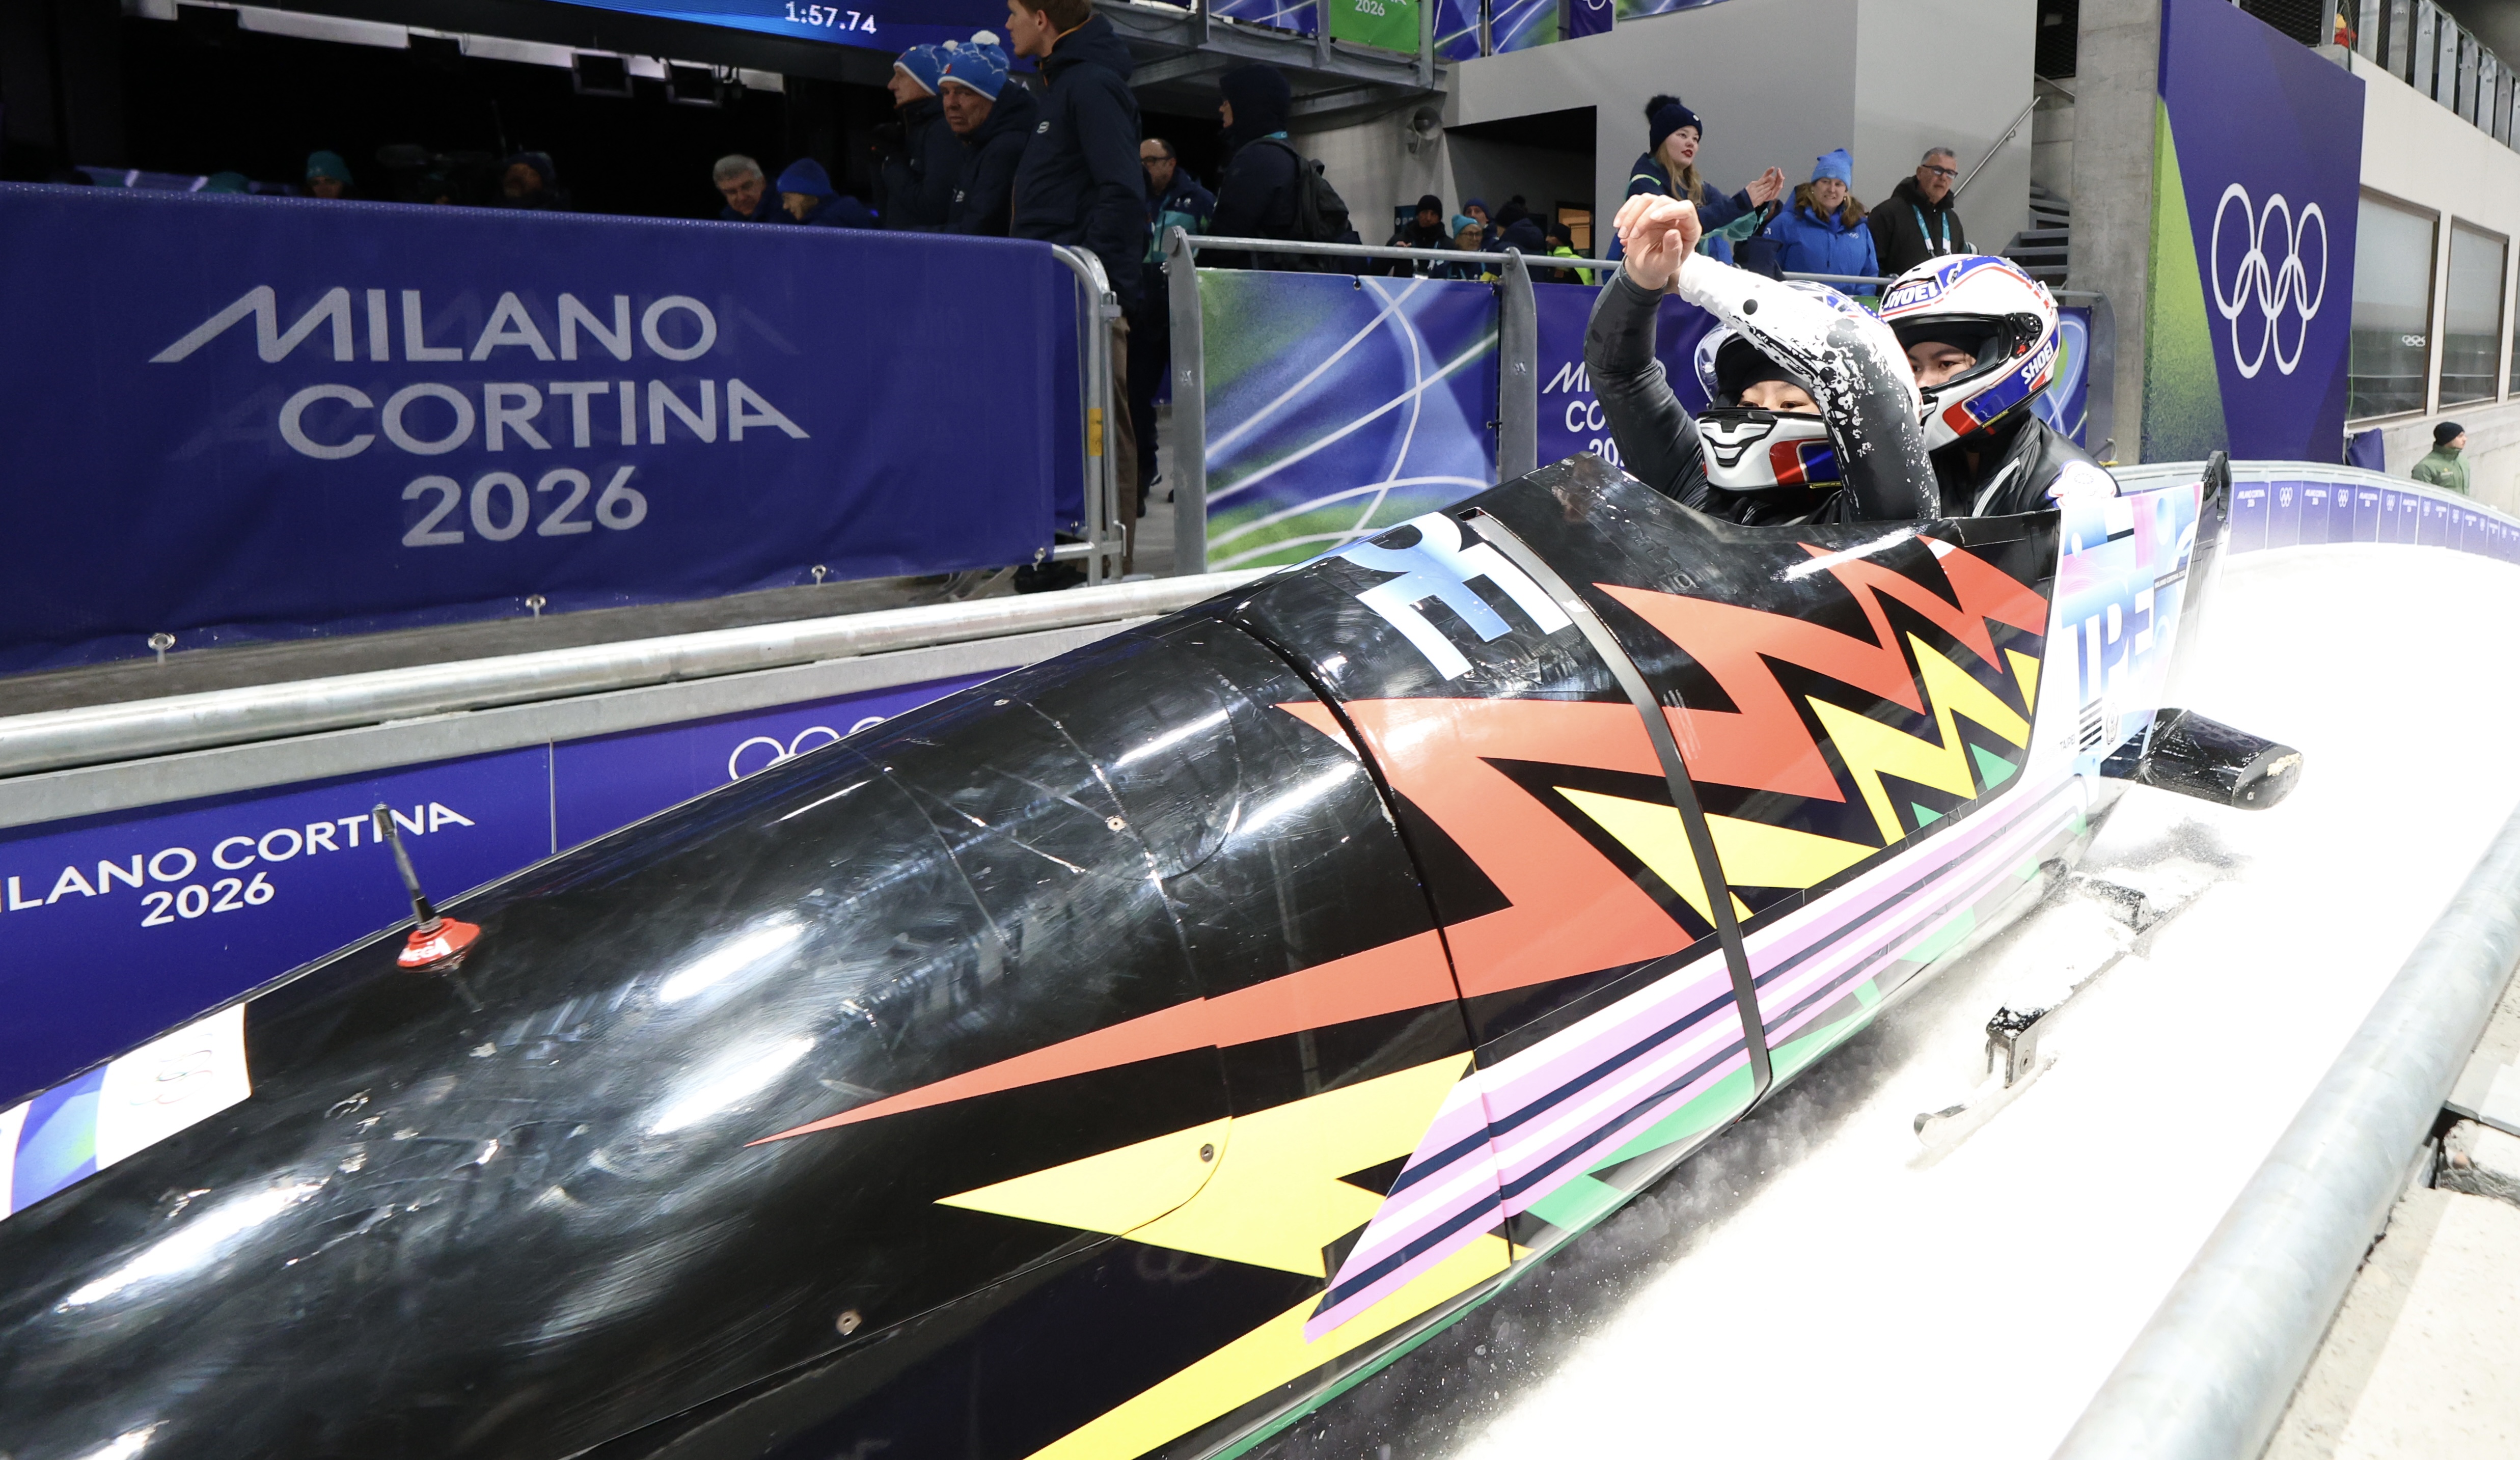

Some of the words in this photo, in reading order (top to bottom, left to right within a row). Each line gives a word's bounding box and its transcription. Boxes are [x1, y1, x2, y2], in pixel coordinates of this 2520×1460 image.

[785, 1, 877, 34] 1:57.74
[1355, 0, 1385, 16] 2026
[148, 284, 717, 363] MILANO
[2021, 340, 2053, 385] SHOEI
[279, 378, 811, 460] CORTINA
[402, 465, 648, 547] 2026
[2061, 564, 2155, 711] TPE
[0, 847, 198, 913] LANO
[211, 802, 475, 870] CORTINA
[141, 871, 275, 927] 2026
